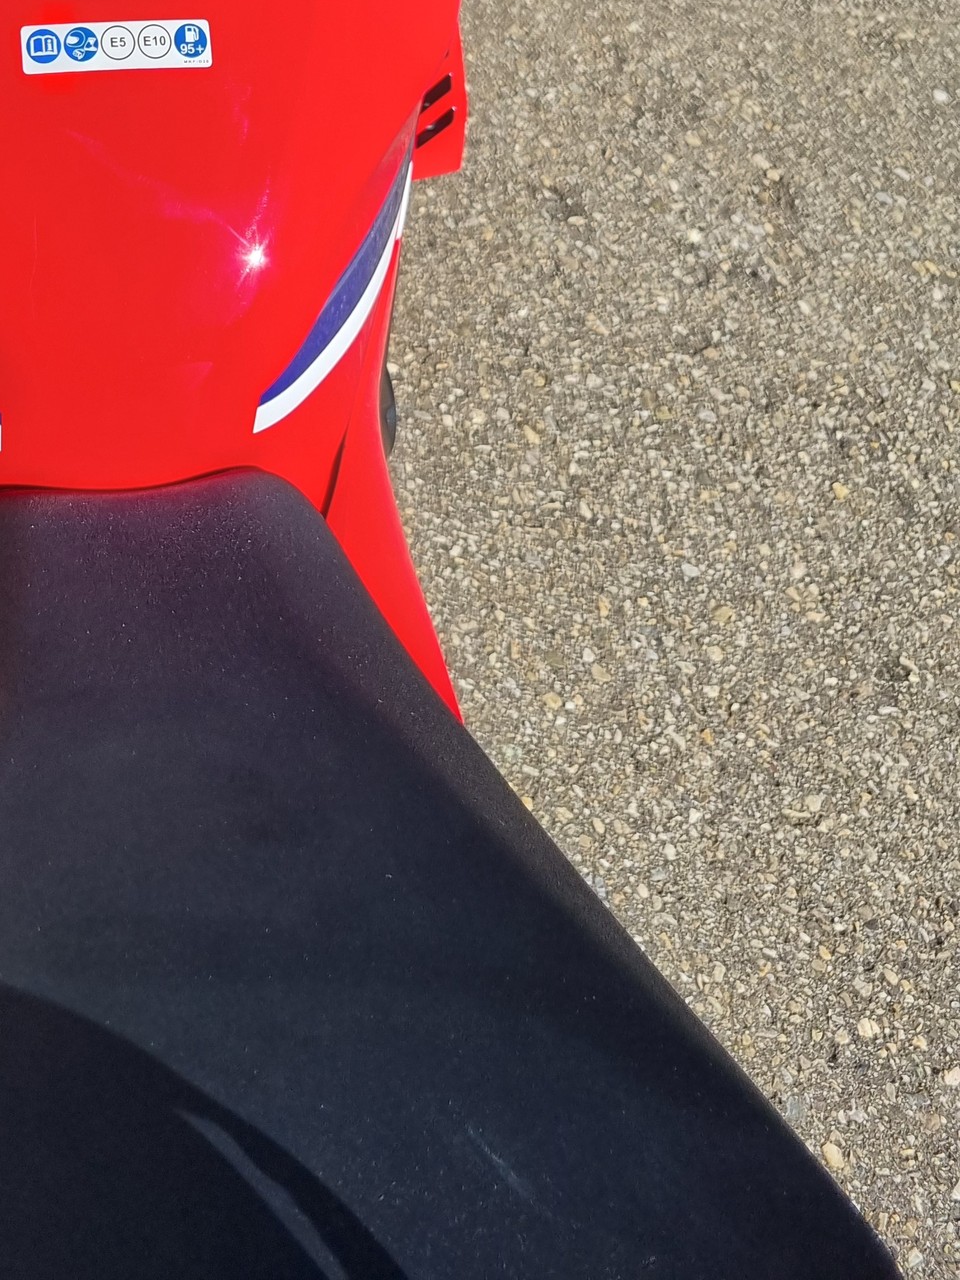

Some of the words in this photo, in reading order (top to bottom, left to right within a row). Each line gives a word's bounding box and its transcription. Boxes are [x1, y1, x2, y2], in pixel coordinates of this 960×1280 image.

[110, 36, 127, 48] E5
[143, 35, 166, 47] E10
[179, 43, 205, 55] 95+
